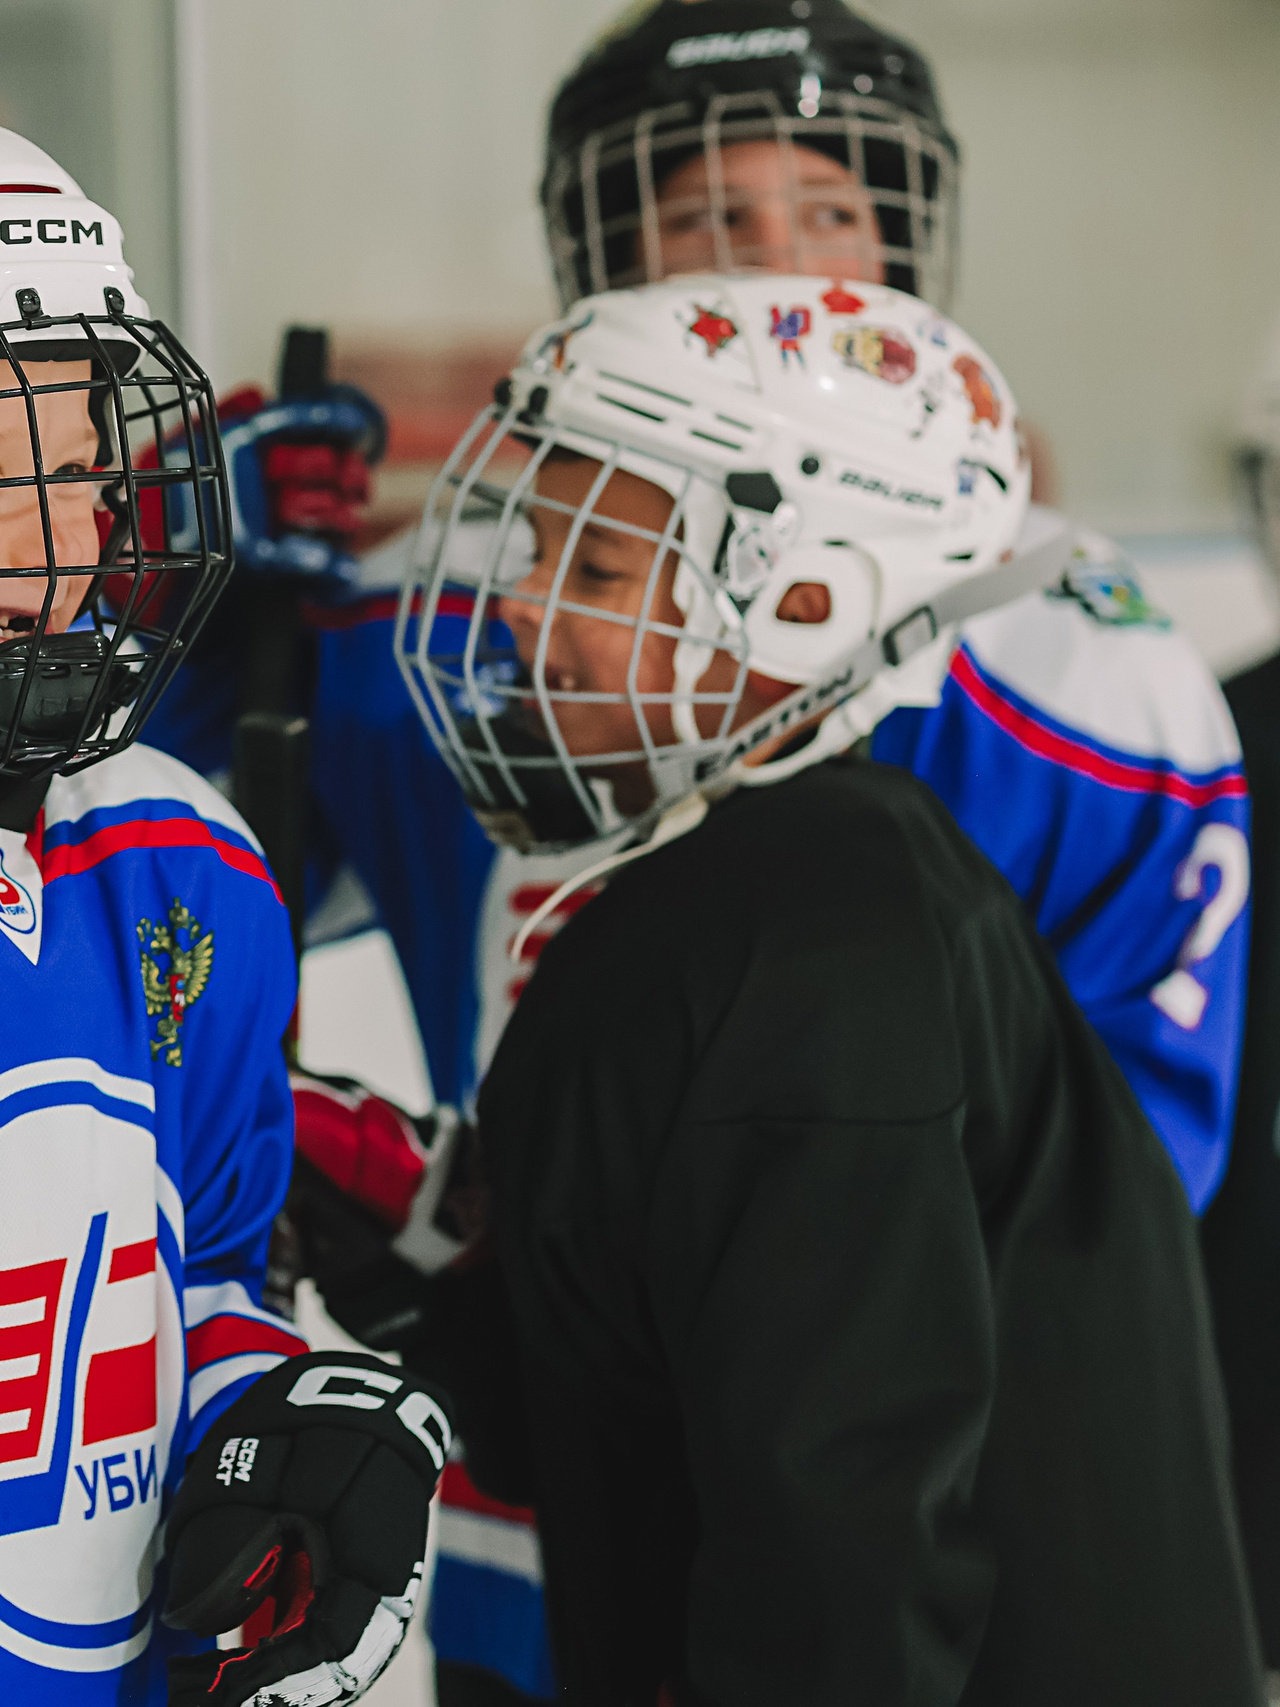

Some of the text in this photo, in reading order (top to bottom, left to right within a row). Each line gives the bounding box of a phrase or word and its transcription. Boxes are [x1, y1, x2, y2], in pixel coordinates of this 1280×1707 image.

[0, 219, 104, 246] CCM
[215, 1437, 243, 1487] NEXT
[234, 1437, 260, 1483] CCM
